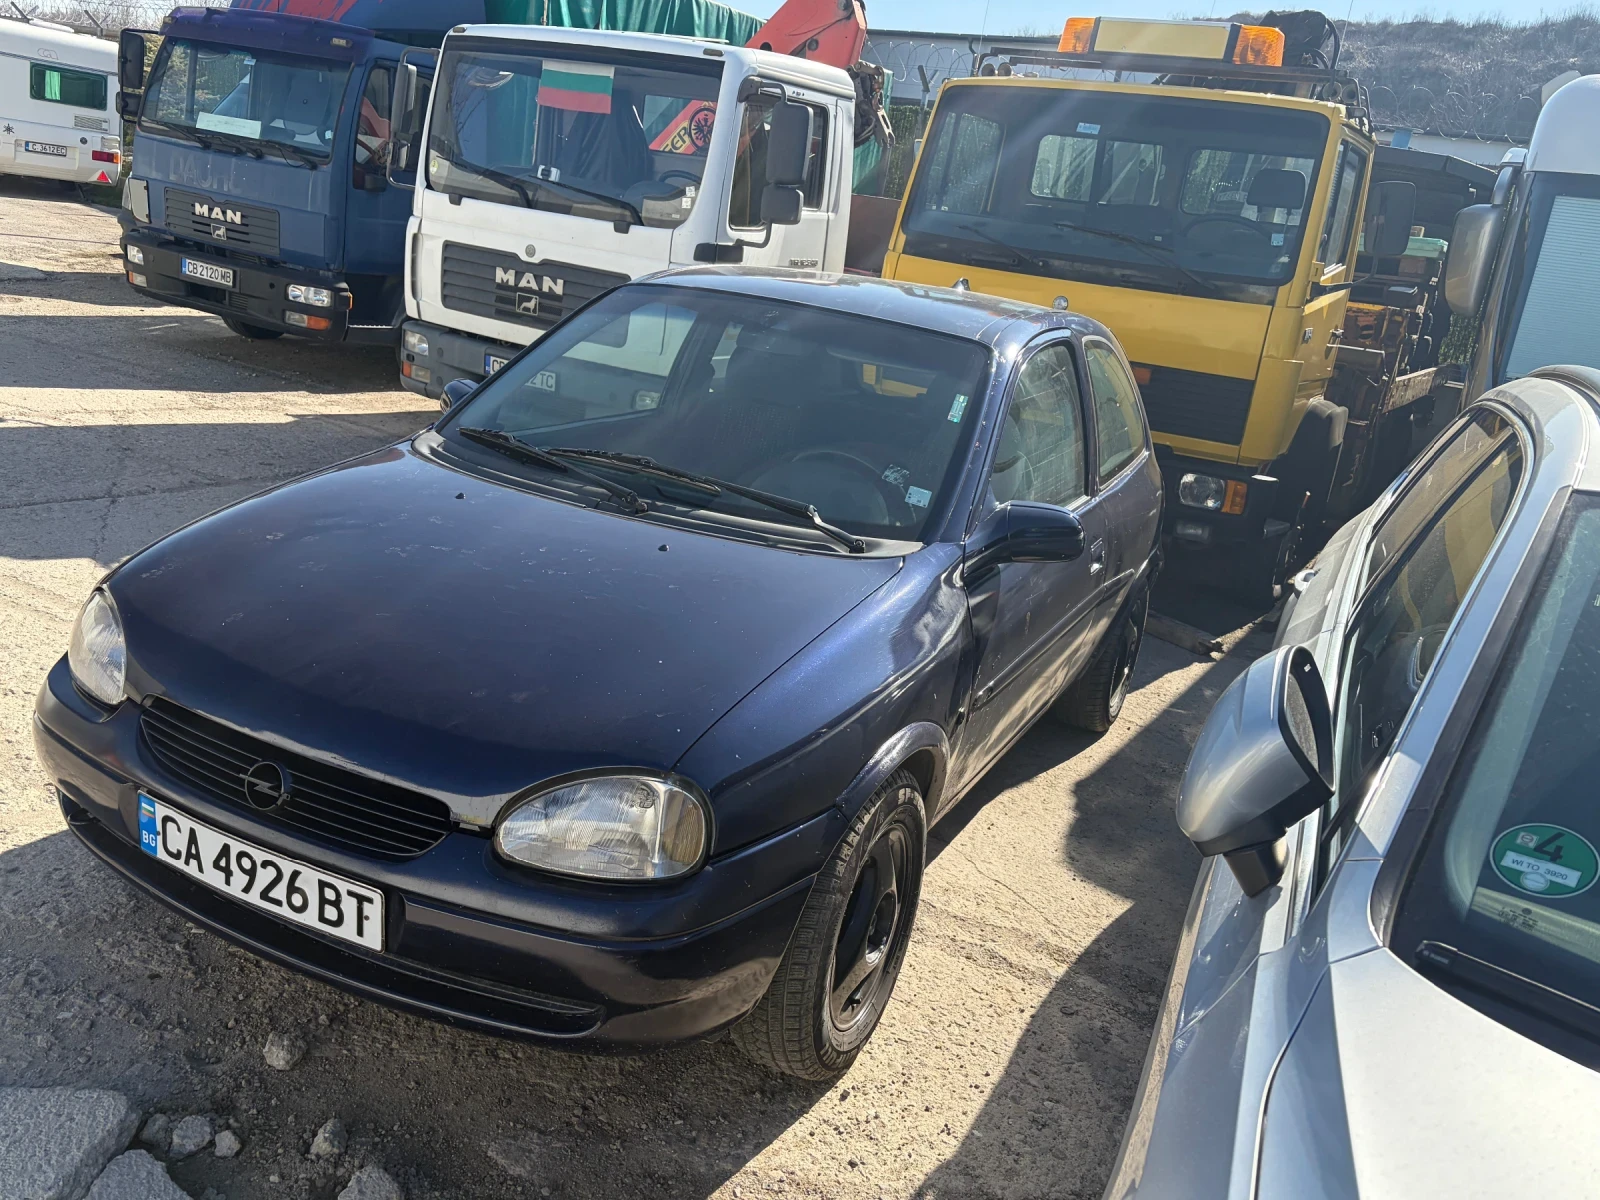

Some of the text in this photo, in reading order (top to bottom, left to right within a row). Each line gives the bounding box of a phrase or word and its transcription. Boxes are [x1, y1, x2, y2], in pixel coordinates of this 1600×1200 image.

[194, 202, 242, 225] MAN
[187, 262, 232, 284] CB 2120 MB
[495, 266, 564, 295] MAN
[142, 829, 156, 847] BG
[1533, 831, 1566, 863] 4
[161, 814, 375, 938] CA 4926 BT
[1511, 858, 1568, 881] WI TO 3920
